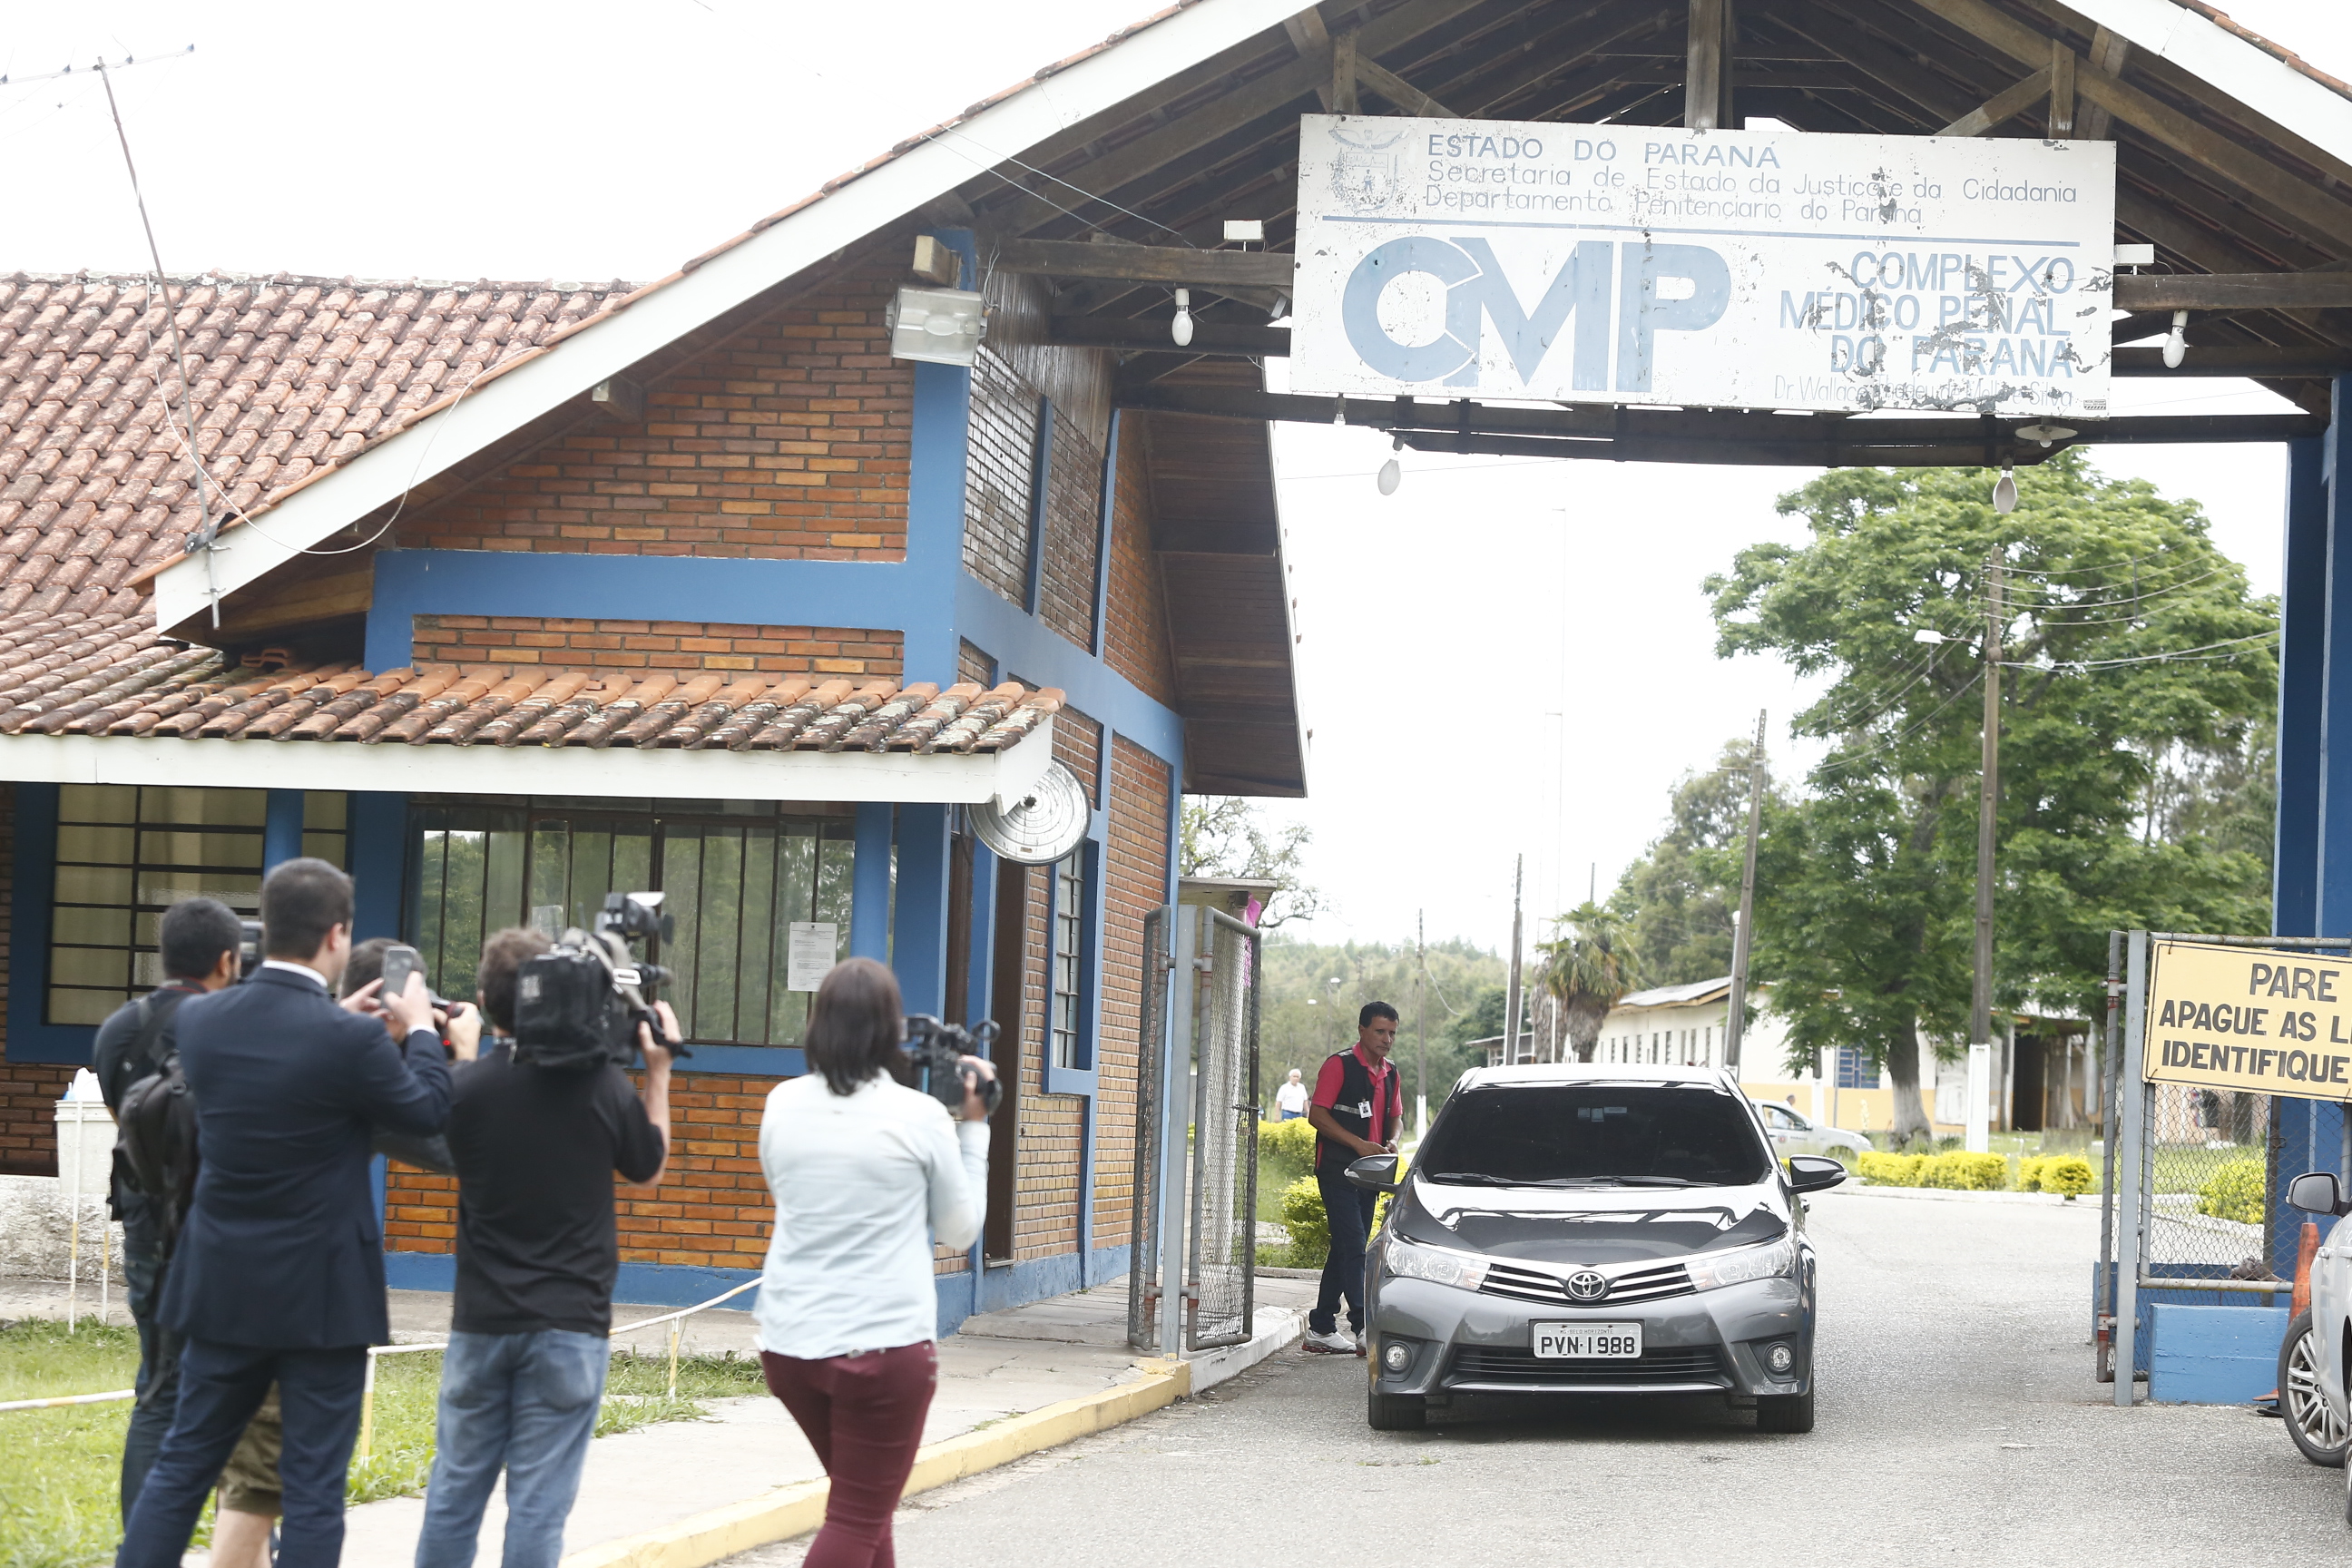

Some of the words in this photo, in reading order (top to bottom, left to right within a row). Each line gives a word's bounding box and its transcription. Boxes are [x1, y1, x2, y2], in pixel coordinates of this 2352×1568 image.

[1428, 134, 1543, 159] ESTADO
[1574, 140, 1617, 162] DO
[1644, 142, 1781, 169] PARANÁ
[1426, 185, 1612, 211] Departamento
[1800, 198, 1828, 220] do
[1428, 161, 1571, 185] Secretaria
[1593, 165, 1625, 187] de
[1647, 168, 1736, 192] Estado
[1749, 172, 1780, 194] da
[1890, 182, 1903, 197] e
[1914, 177, 1941, 198] da
[1963, 178, 2077, 203] Cidadania
[1850, 251, 2074, 294] COMPLEXO
[1342, 236, 1730, 393] CMP
[1779, 286, 1920, 331] MÉDICO
[1939, 295, 2071, 336] PENAL
[1831, 335, 1886, 377] DO
[1799, 376, 1869, 401] Wallace
[2030, 381, 2073, 407] Silva
[2249, 963, 2340, 1003] PARE
[2159, 1000, 2269, 1035] APAGUE
[2279, 1011, 2317, 1042] AS
[2161, 1040, 2350, 1083] IDENTIFIQUE
